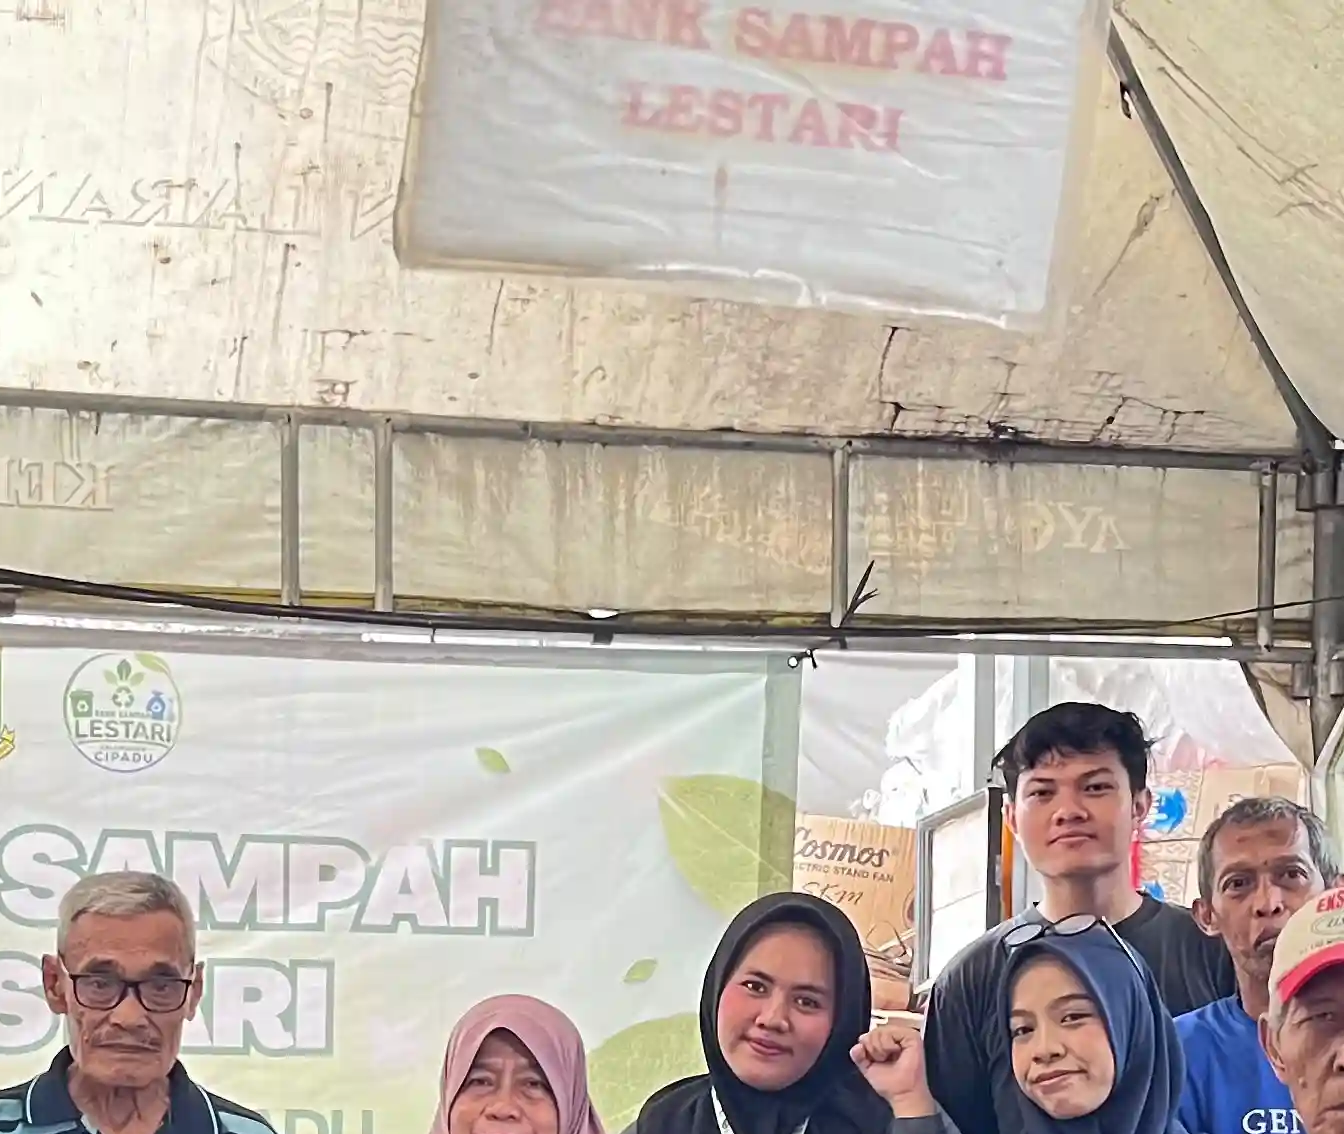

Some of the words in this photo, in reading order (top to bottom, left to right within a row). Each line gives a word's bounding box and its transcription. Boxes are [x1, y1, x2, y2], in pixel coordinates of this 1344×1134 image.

[732, 3, 1013, 82] SAMPAH
[618, 79, 906, 153] LESTARI
[76, 719, 172, 742] LESTARI
[93, 751, 153, 764] CIPADU
[795, 826, 890, 868] Cosmos
